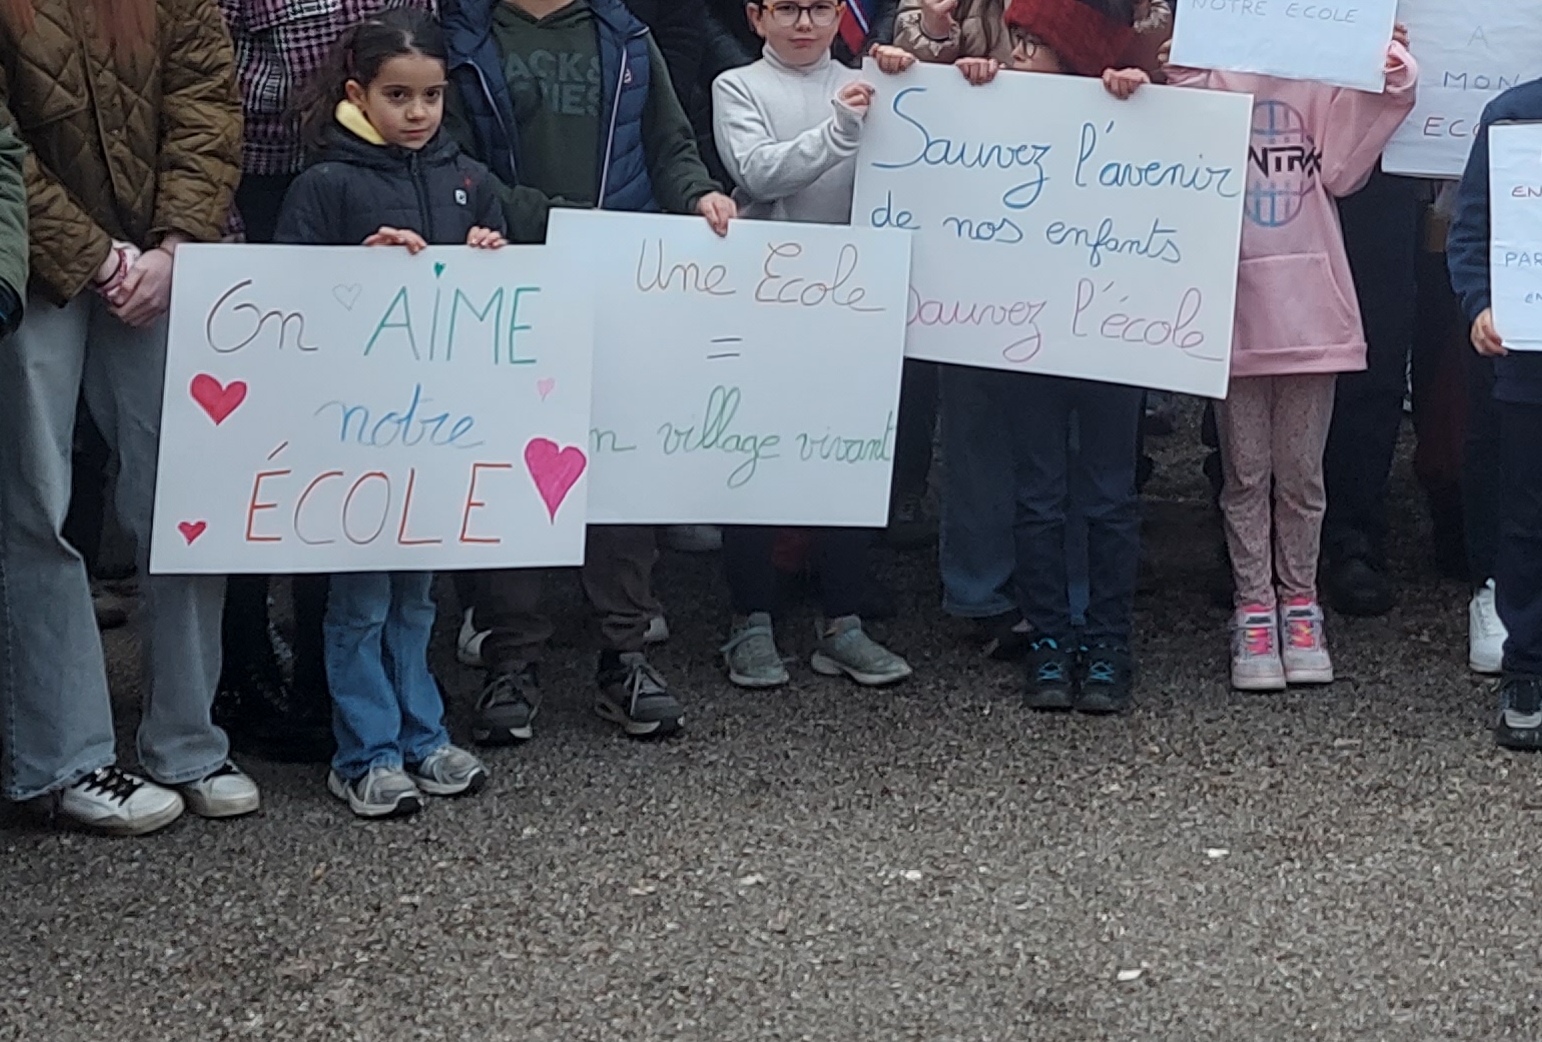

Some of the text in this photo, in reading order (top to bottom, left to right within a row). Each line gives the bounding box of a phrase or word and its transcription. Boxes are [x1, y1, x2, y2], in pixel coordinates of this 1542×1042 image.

[1466, 24, 1489, 47] A
[1443, 70, 1520, 90] MON
[871, 86, 1242, 209] Sauvez l'avenir
[871, 190, 1181, 268] de nos enfants
[1511, 184, 1542, 199] EN
[636, 238, 887, 312] Une Ecole
[206, 279, 318, 354] On
[1071, 277, 1225, 362] l'école
[314, 383, 484, 448] notre
[657, 385, 782, 489] village
[795, 410, 896, 464] vivant
[246, 441, 512, 546] ÉCOLE
